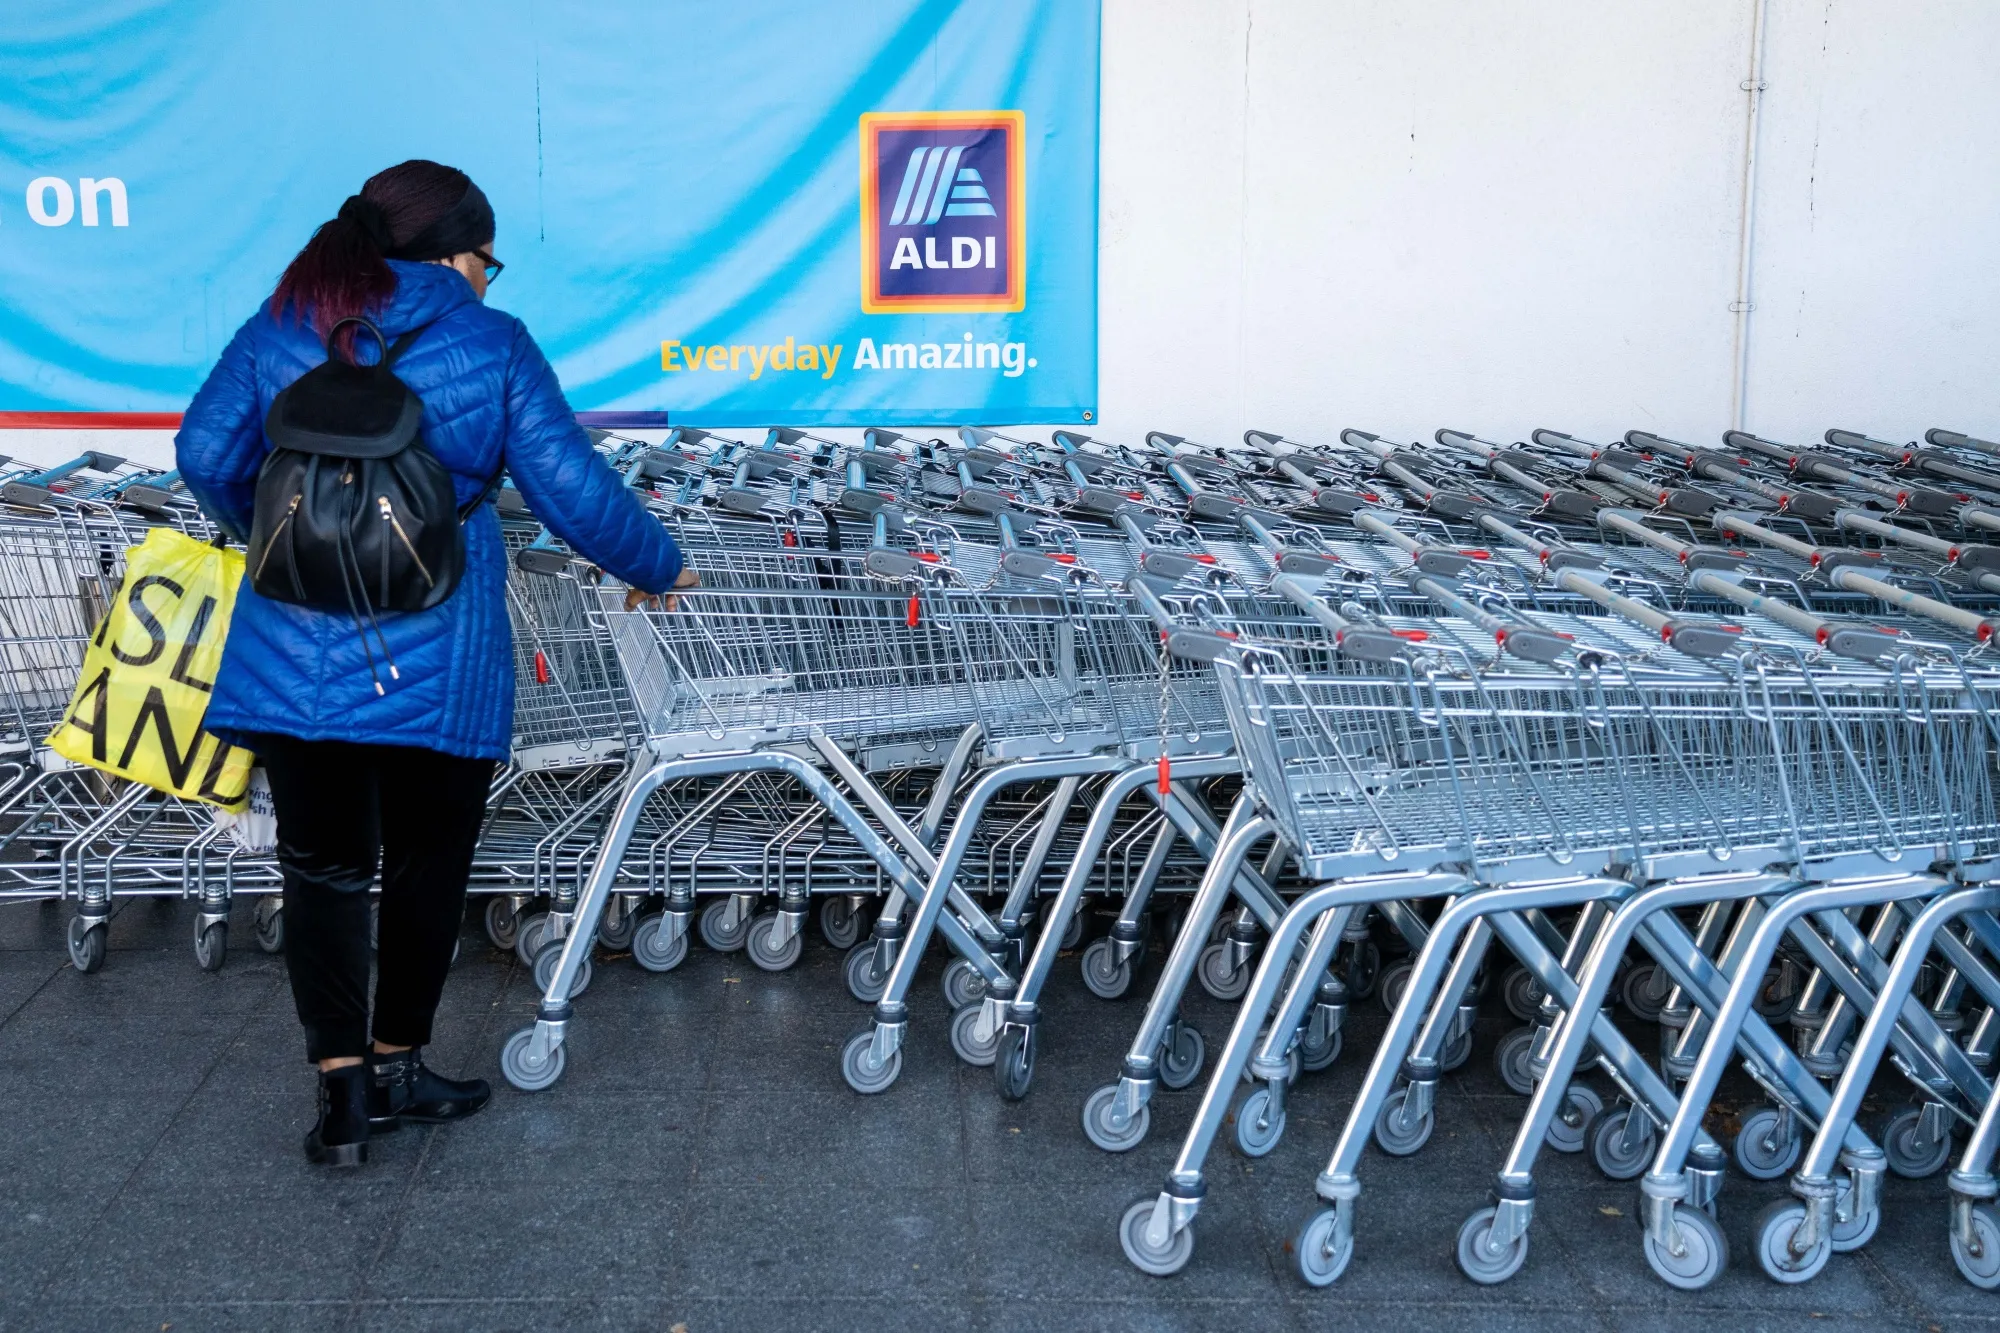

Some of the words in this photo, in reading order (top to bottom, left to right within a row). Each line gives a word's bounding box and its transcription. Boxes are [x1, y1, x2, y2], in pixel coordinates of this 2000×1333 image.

[26, 176, 129, 227] on
[889, 236, 996, 270] ALDI
[661, 336, 842, 380] Everyday
[853, 332, 1038, 377] Amazing.
